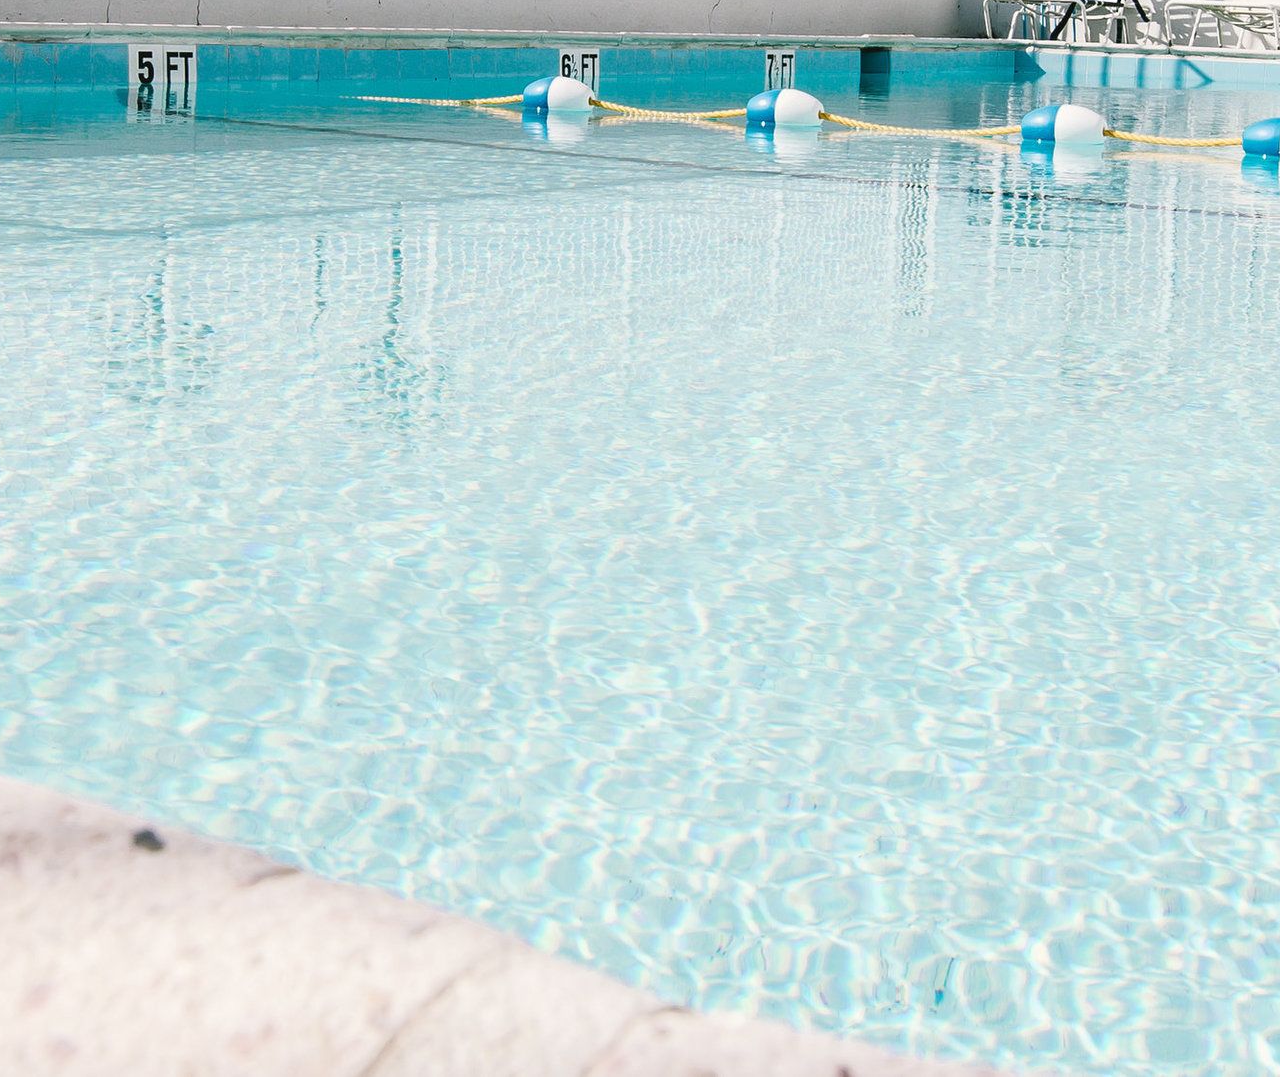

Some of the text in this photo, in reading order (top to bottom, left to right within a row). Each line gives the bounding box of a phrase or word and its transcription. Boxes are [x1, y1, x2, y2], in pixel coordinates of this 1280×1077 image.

[138, 51, 194, 84] 5 FT
[581, 53, 598, 82] FT
[781, 53, 794, 76] FT
